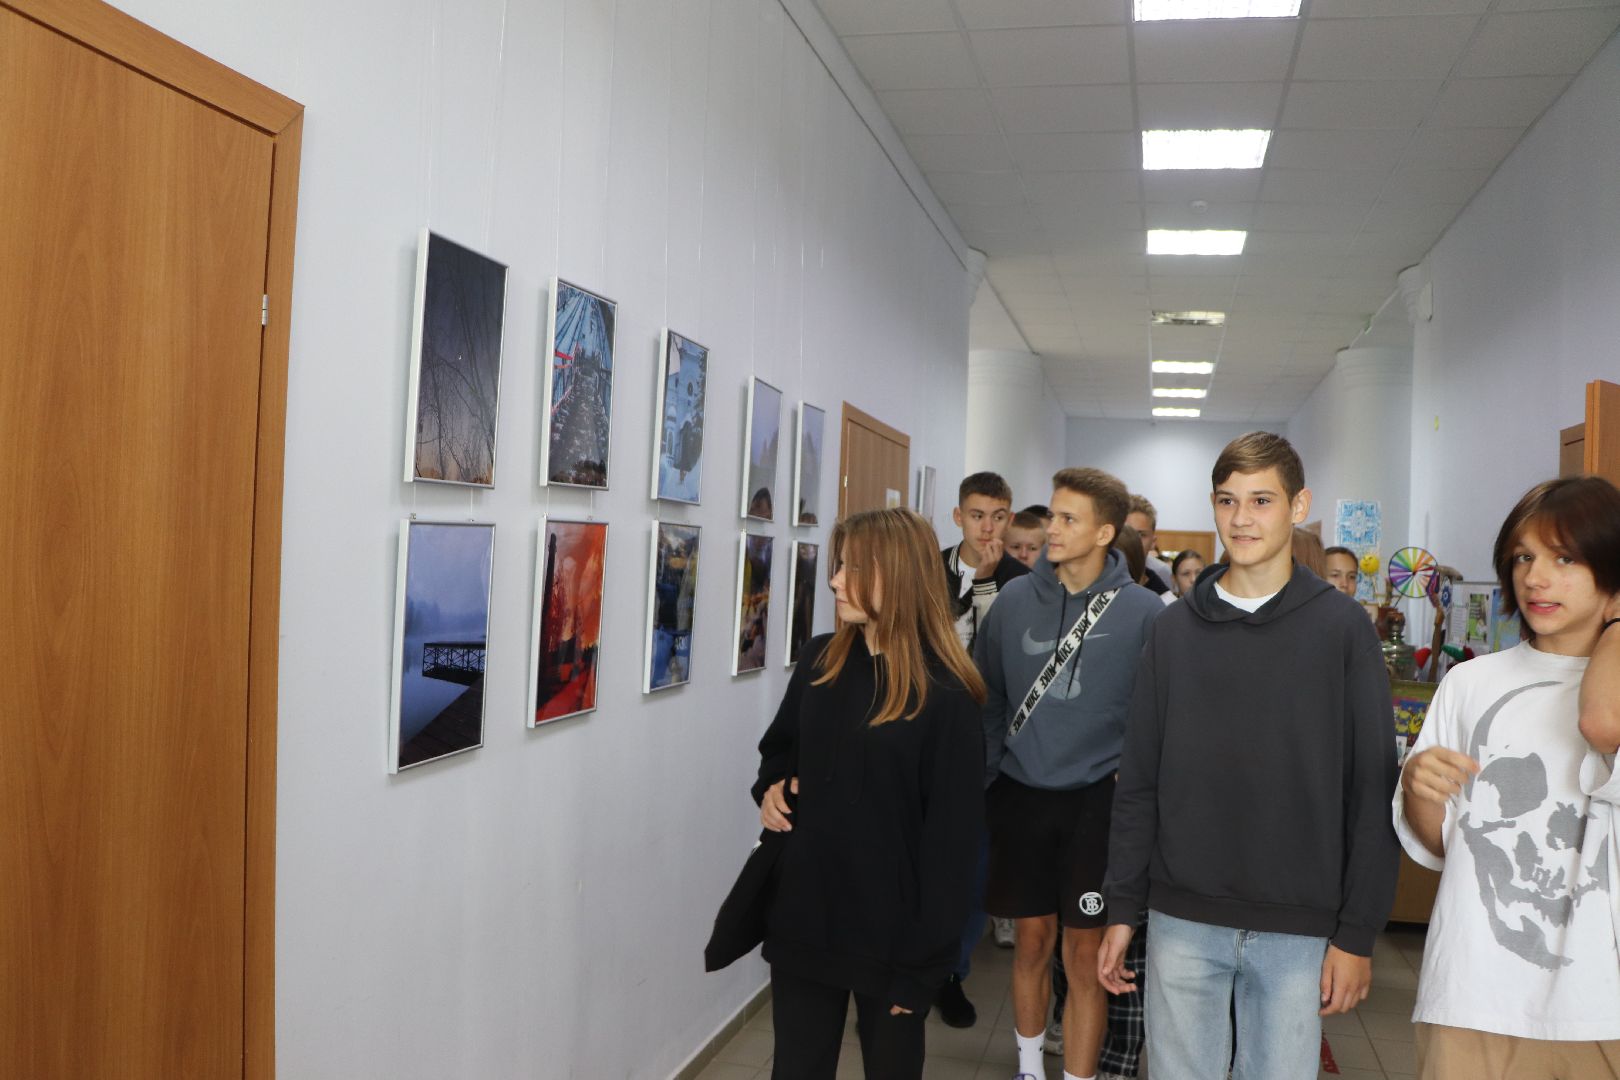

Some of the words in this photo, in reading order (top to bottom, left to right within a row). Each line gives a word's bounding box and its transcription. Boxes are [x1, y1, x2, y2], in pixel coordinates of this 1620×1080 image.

[1025, 687, 1041, 712] NIKE
[1040, 663, 1057, 689] NIKE
[1056, 640, 1074, 666] NIKE
[1090, 592, 1111, 617] NIKE
